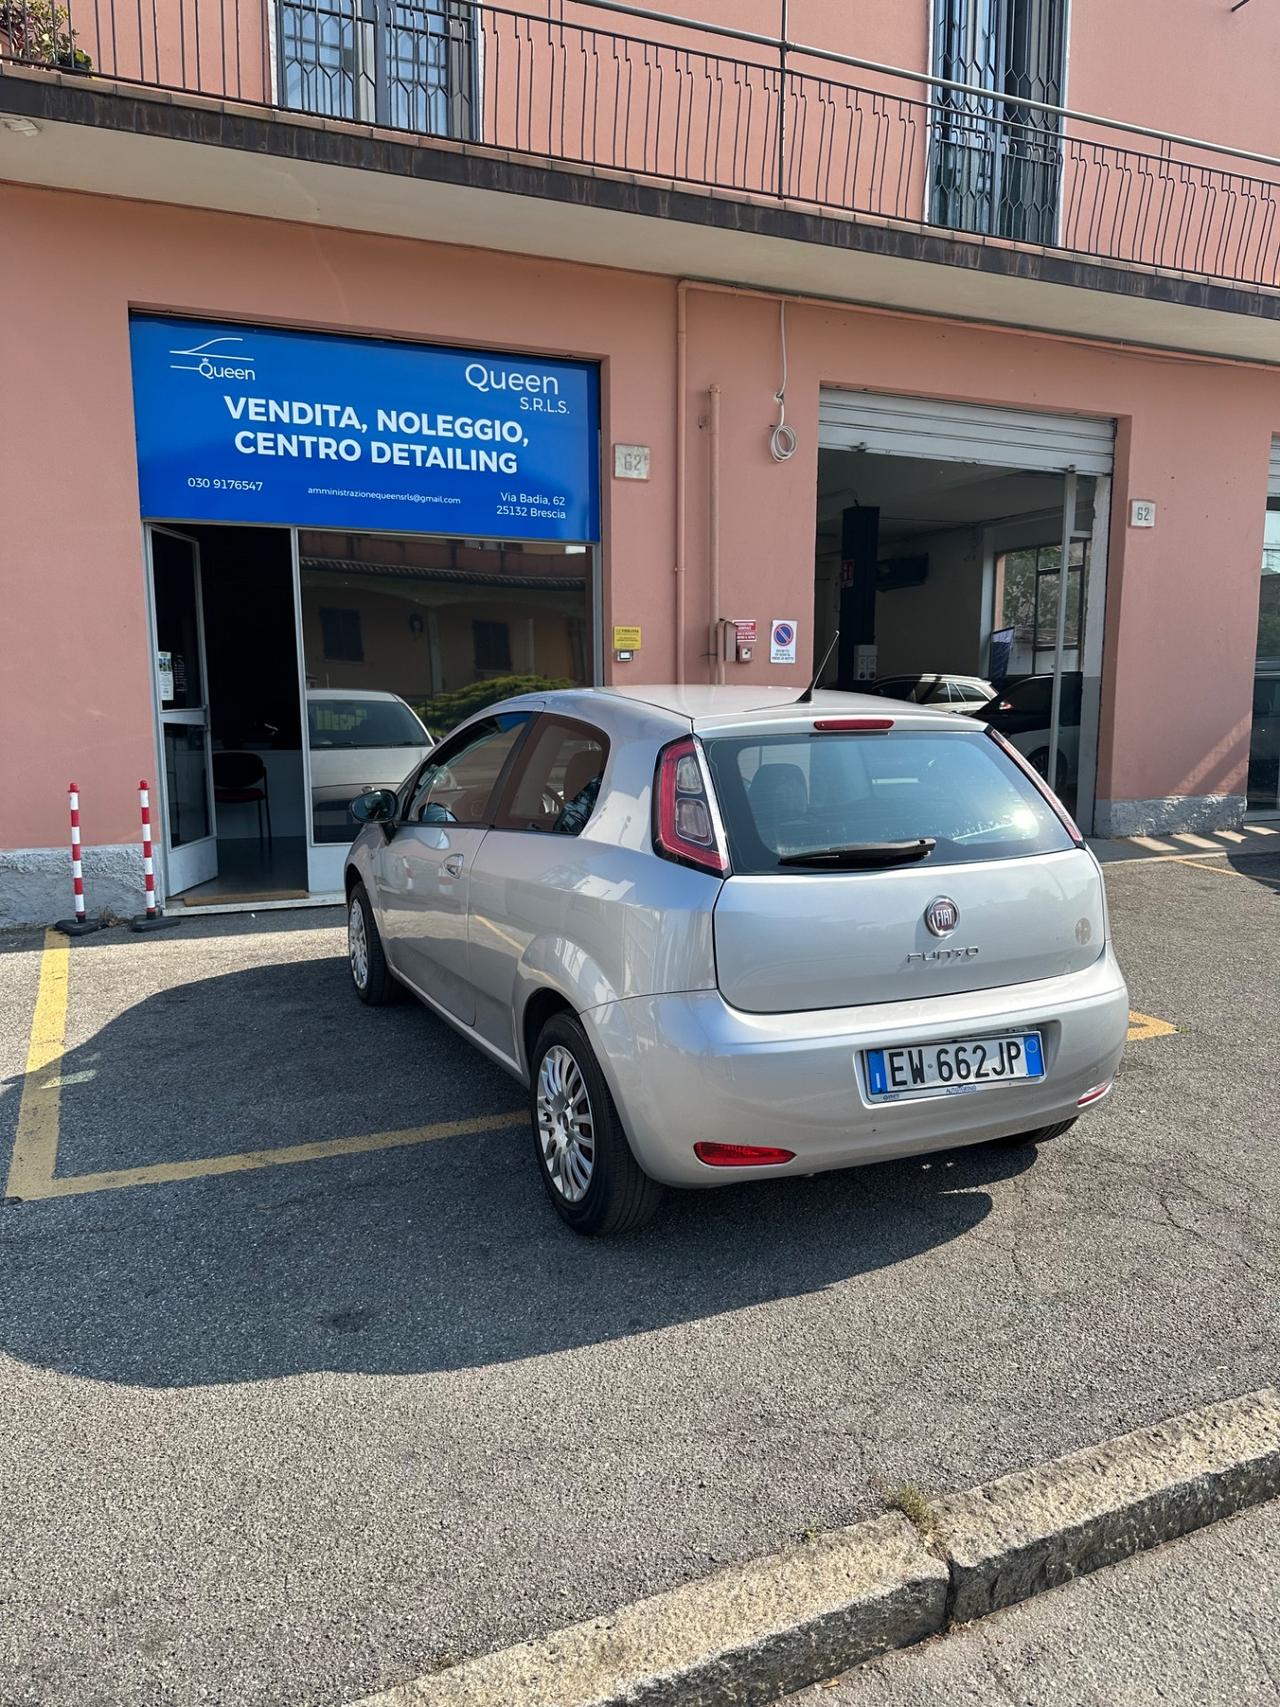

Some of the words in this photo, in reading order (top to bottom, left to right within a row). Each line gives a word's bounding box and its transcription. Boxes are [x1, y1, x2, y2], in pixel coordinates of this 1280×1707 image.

[199, 362, 256, 381] Queen
[465, 363, 559, 395] Queen
[520, 396, 570, 414] S.R.L.S.
[223, 395, 368, 433] VENDITA,
[377, 409, 529, 447] NOLEGGIO,
[234, 430, 362, 462] CENTRO
[370, 441, 517, 474] DETAILING
[187, 477, 210, 488] 030
[213, 479, 263, 491] 9176547
[307, 486, 461, 505] amministrazionequeensrls@gmail.com
[500, 492, 517, 502] Via
[520, 494, 550, 506] Badia,
[553, 496, 566, 506] 62
[496, 505, 528, 517] 25132
[530, 508, 566, 519] Brescia
[1137, 506, 1150, 521] 62
[935, 909, 953, 926] FIAT
[888, 1049, 926, 1087] EW
[936, 1040, 1022, 1083] 662JP
